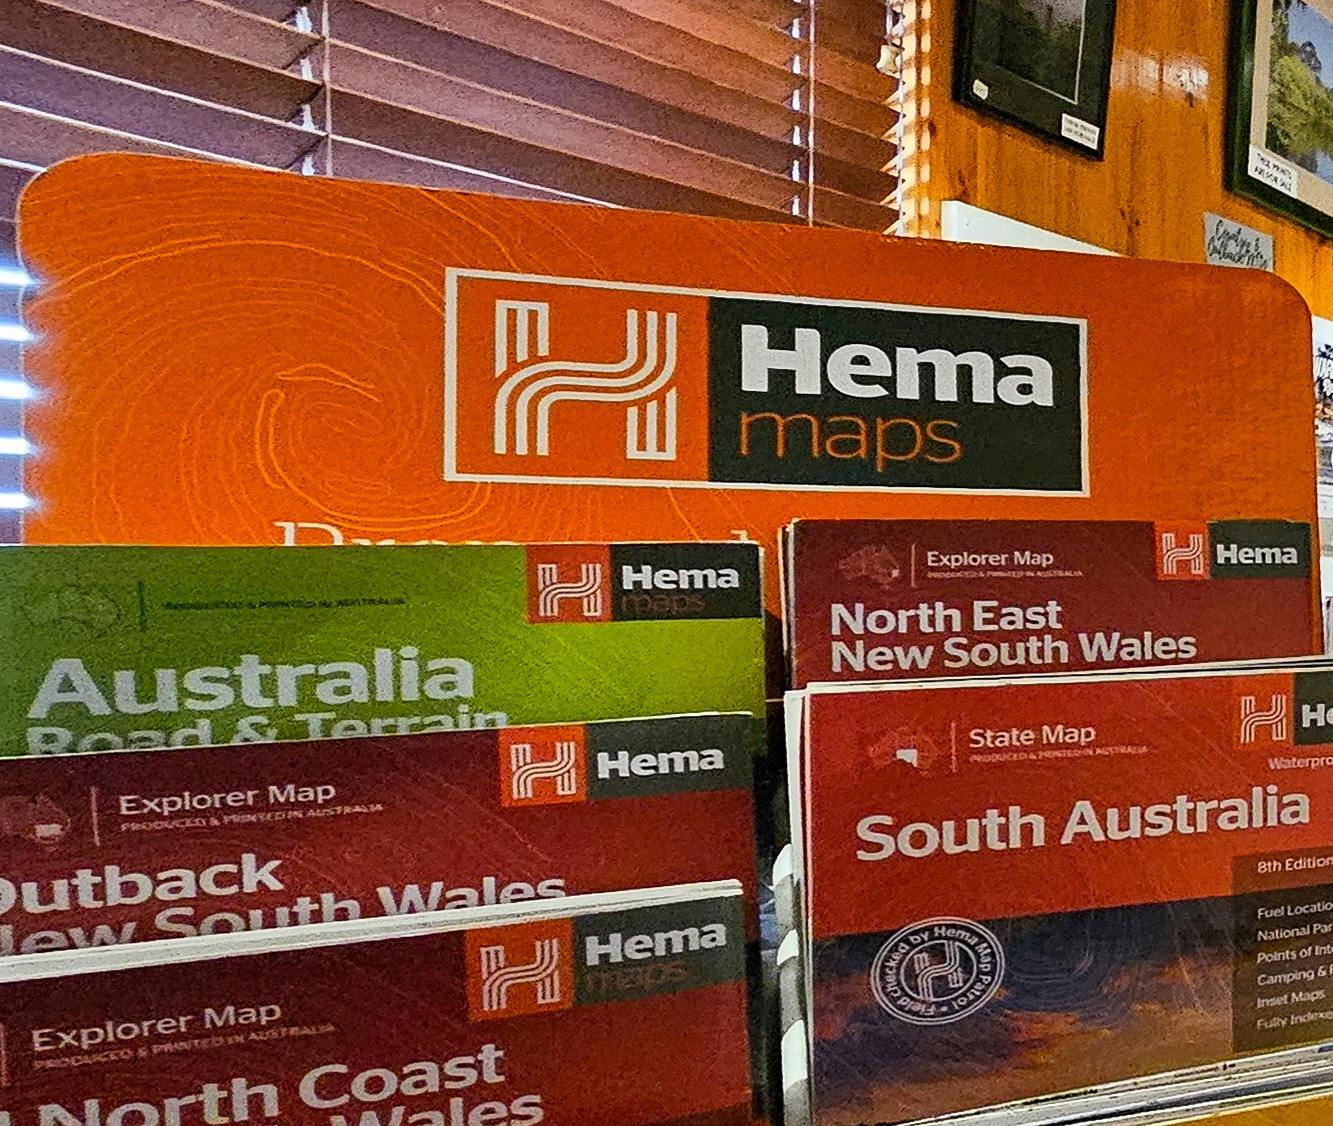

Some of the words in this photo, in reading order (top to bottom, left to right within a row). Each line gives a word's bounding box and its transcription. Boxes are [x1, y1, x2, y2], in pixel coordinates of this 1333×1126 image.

[741, 323, 1053, 406] Hema
[740, 410, 962, 471] maps
[927, 550, 1008, 569] Explorer
[1013, 550, 1054, 568] Map
[1216, 543, 1298, 565] Hema
[622, 564, 739, 590] Hema
[830, 602, 956, 637] North
[972, 600, 1063, 631] East
[830, 641, 934, 674] New
[942, 634, 1069, 669] South
[1077, 631, 1197, 664] Wales
[27, 646, 475, 719] Australia
[969, 727, 1036, 751] State
[1042, 723, 1097, 748] Map
[597, 749, 725, 779] Hema
[119, 788, 260, 817] Explorer
[268, 784, 337, 805] Map
[856, 804, 1047, 862] South
[1061, 784, 1312, 846] Australia
[1257, 859, 1282, 874] 8th
[1257, 906, 1285, 920] Fuel
[585, 923, 727, 966] Hema
[1257, 924, 1311, 941] National
[1256, 948, 1297, 964] Points
[1299, 945, 1312, 958] of
[1257, 968, 1315, 986] Camping
[1317, 964, 1327, 977] &
[1290, 989, 1326, 1005] Maps
[32, 1012, 194, 1052] Explorer
[204, 1003, 282, 1030] Map
[1256, 1014, 1288, 1030] Fully
[300, 1042, 505, 1109] Coast
